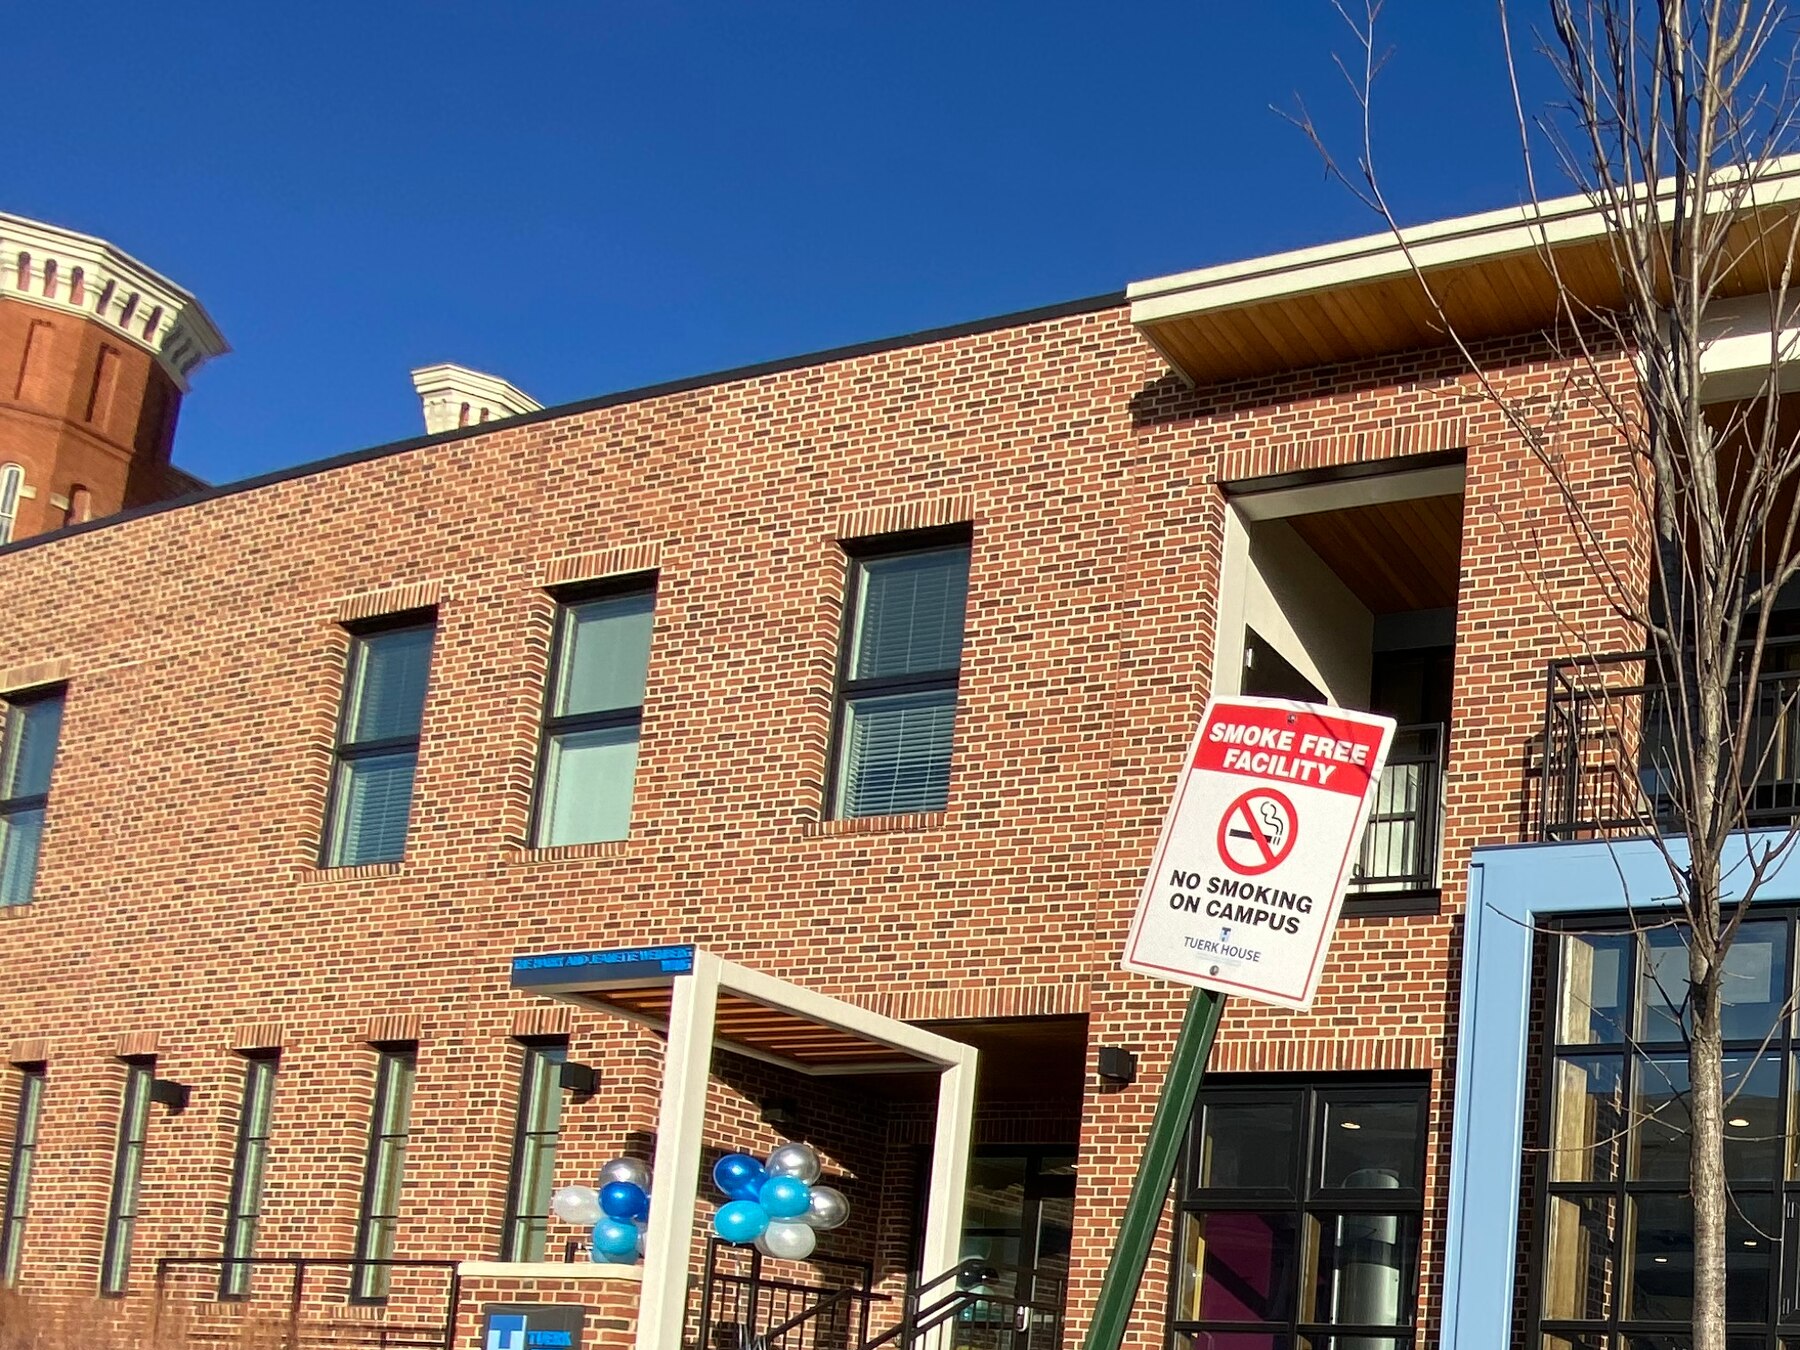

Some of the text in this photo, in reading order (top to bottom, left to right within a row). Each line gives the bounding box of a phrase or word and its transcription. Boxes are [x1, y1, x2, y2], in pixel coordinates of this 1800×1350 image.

[1209, 721, 1370, 766] SMOKE FREE
[1222, 748, 1337, 785] FACILITY
[1169, 869, 1314, 915] NO SMOKING
[1169, 893, 1301, 935] ON CAMPUS
[1184, 936, 1219, 954] TUERK
[1220, 943, 1262, 963] HOUSE
